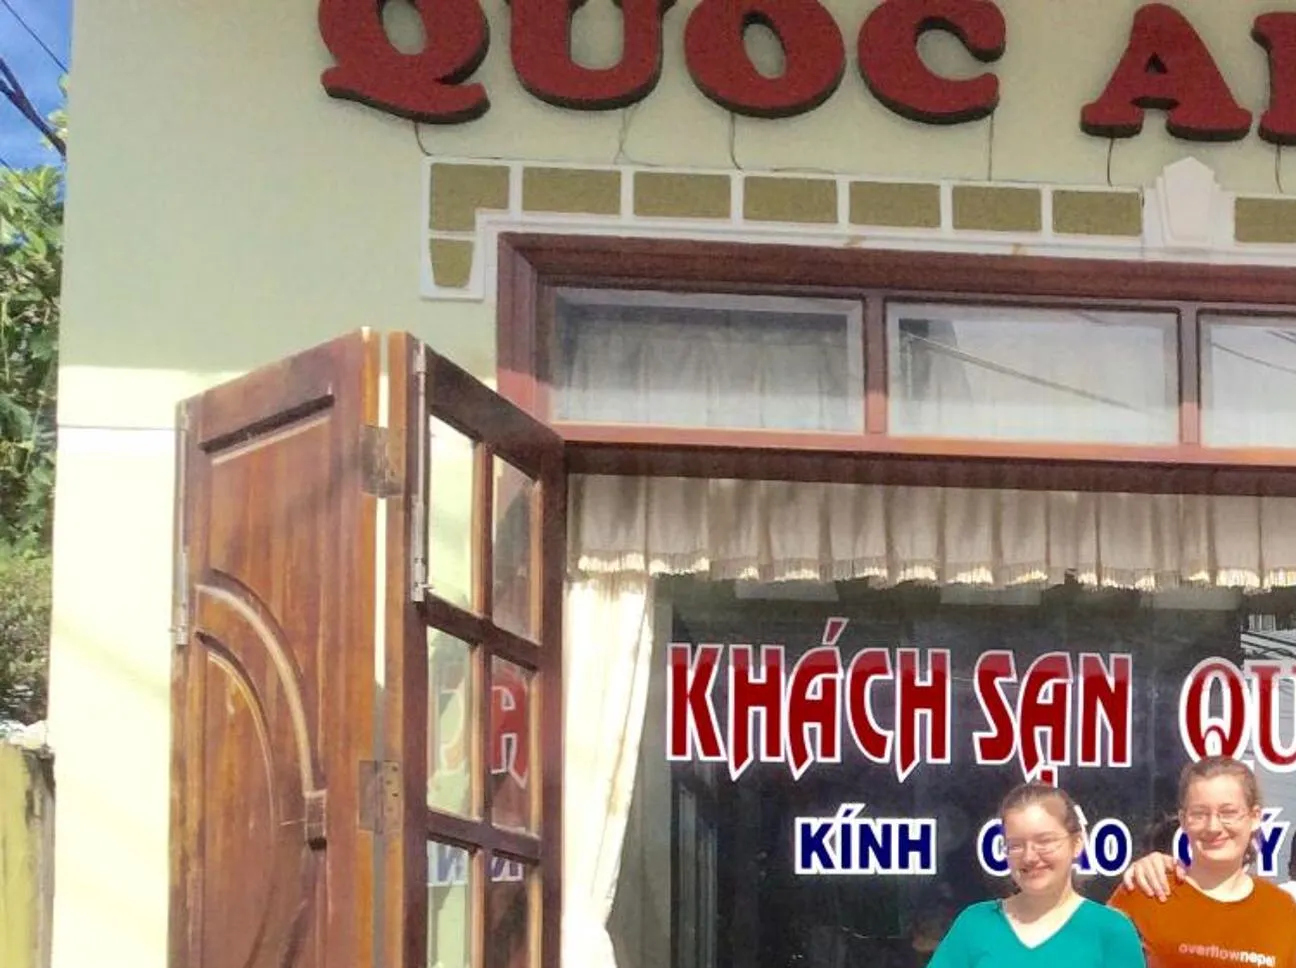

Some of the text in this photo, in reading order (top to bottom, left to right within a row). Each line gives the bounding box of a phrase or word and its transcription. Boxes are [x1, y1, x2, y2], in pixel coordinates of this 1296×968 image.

[666, 616, 952, 783] KHÁCH
[972, 649, 1134, 788] SẠN
[794, 803, 937, 875] KÍNH
